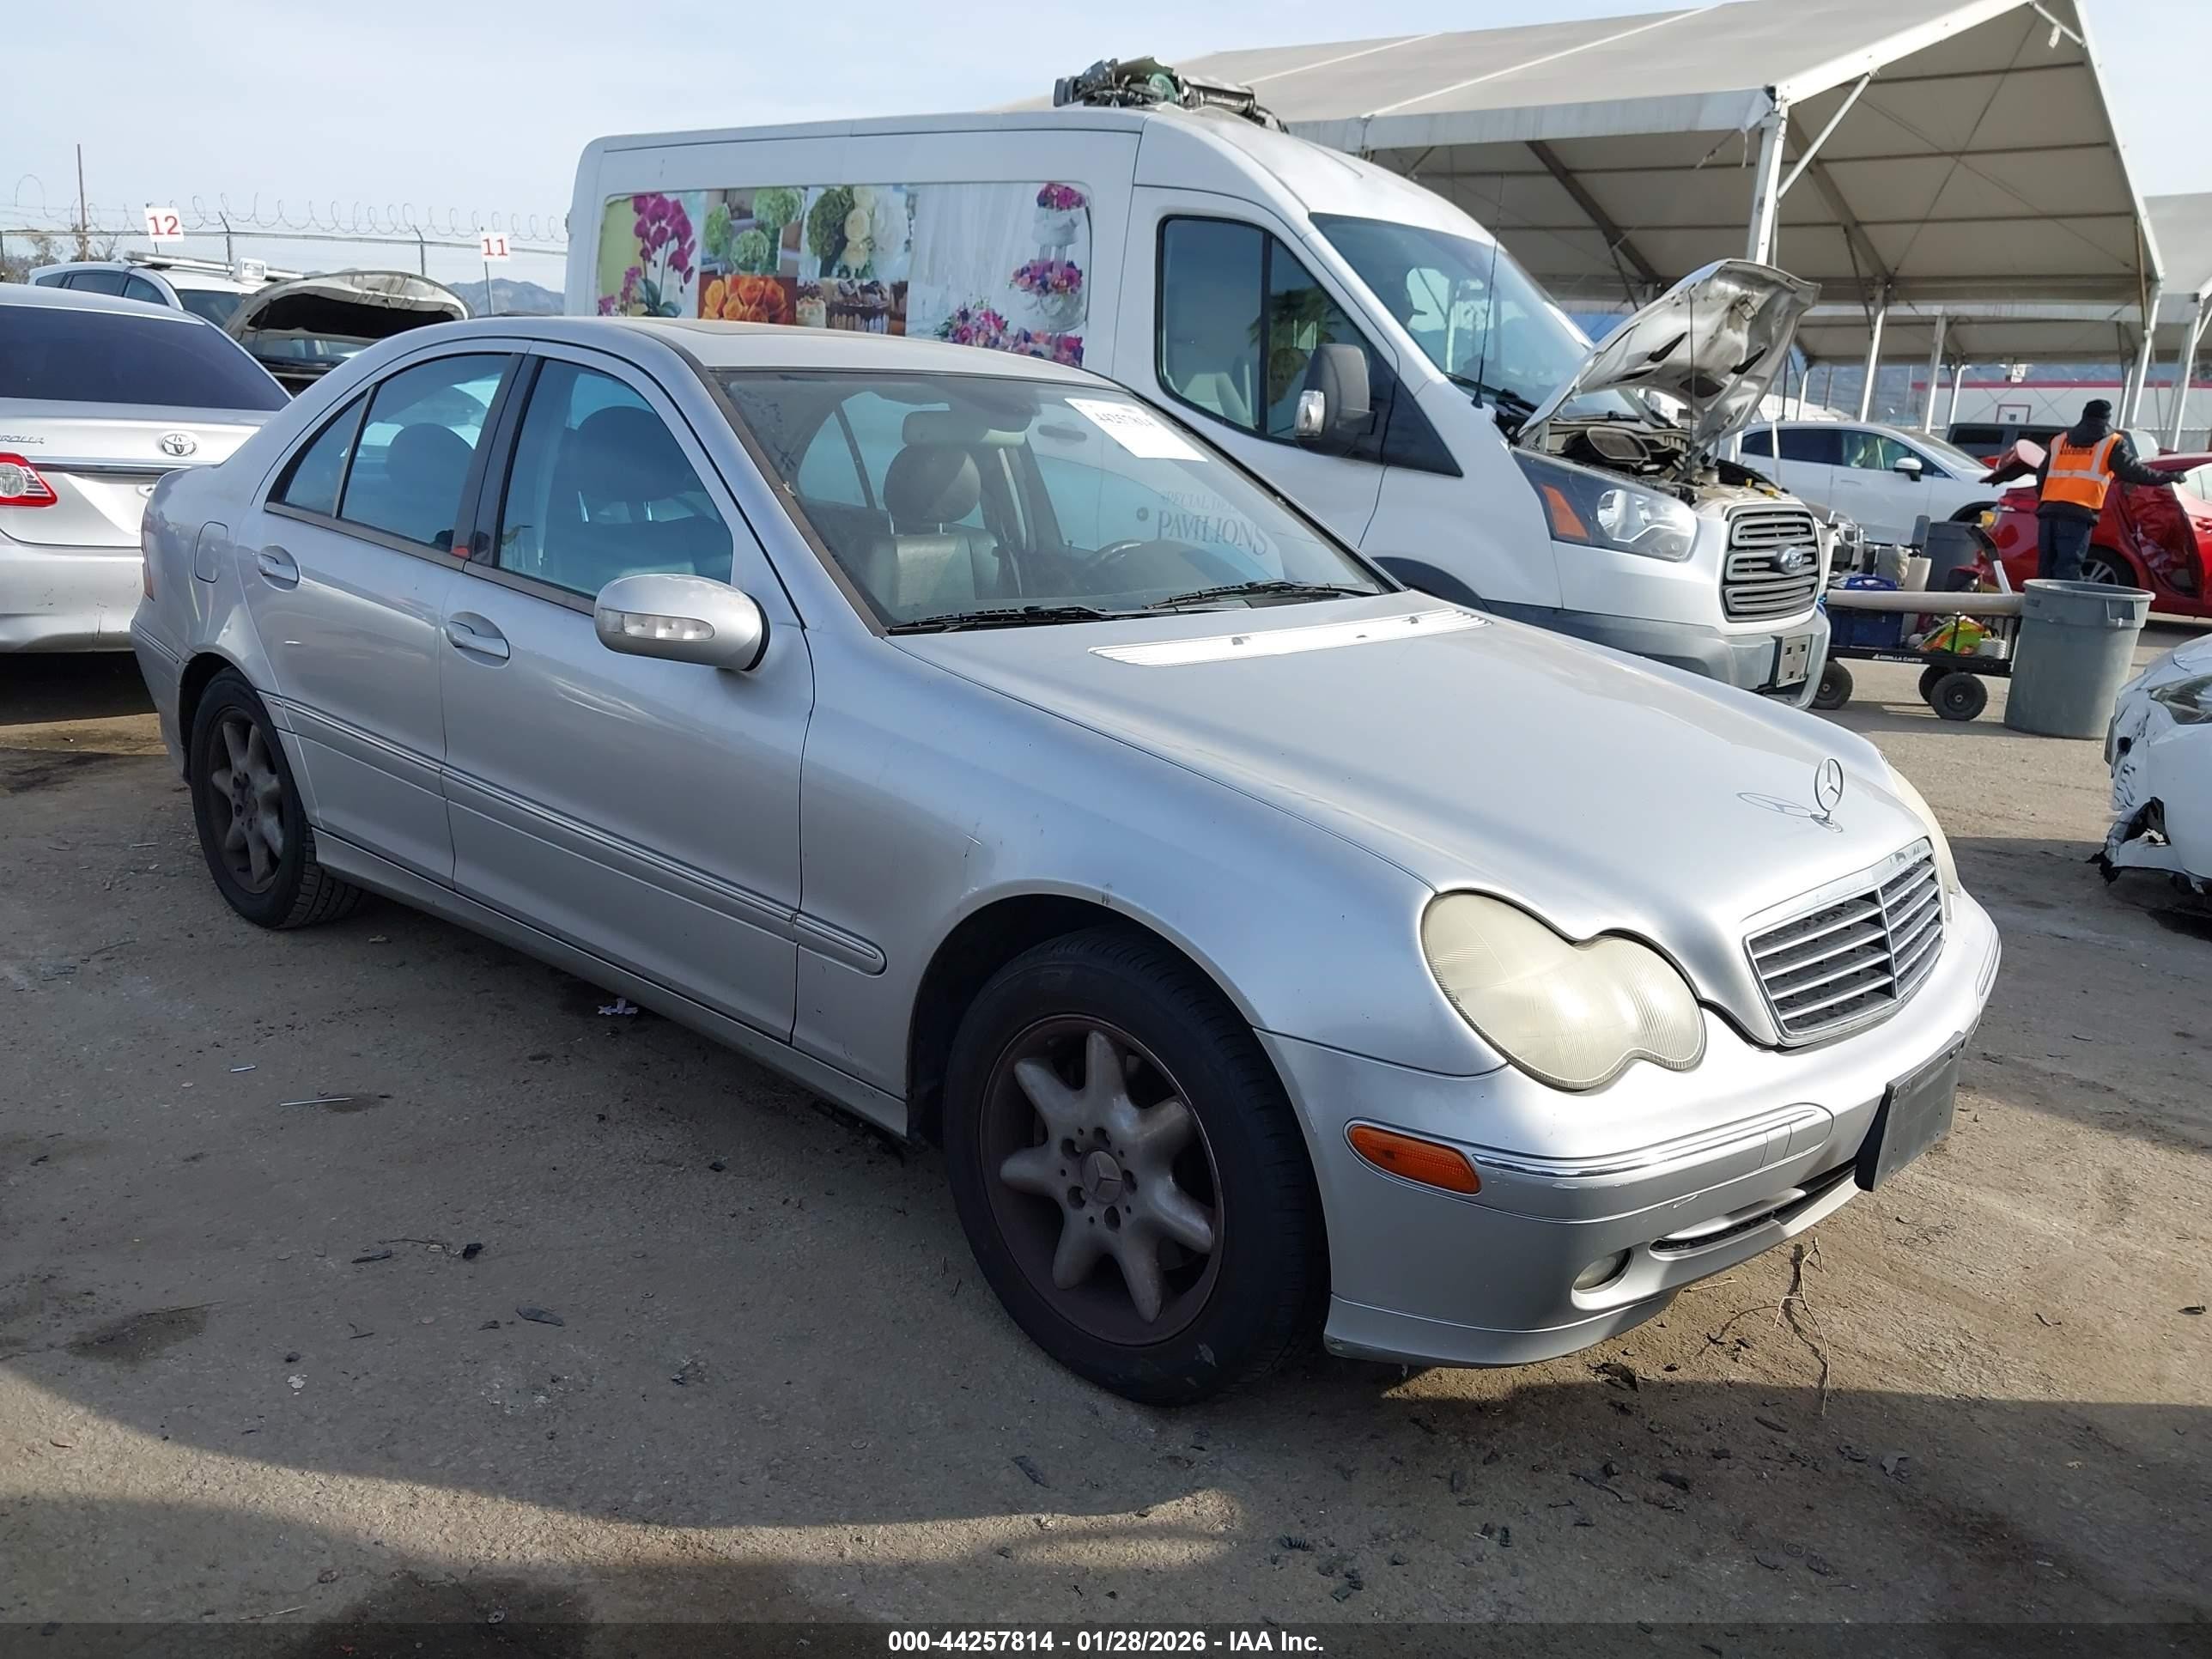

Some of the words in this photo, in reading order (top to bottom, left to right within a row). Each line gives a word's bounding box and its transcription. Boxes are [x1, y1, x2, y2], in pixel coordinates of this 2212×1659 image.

[149, 216, 180, 235] 12
[482, 237, 508, 256] 11
[1157, 509, 1268, 556] PAVILIONS
